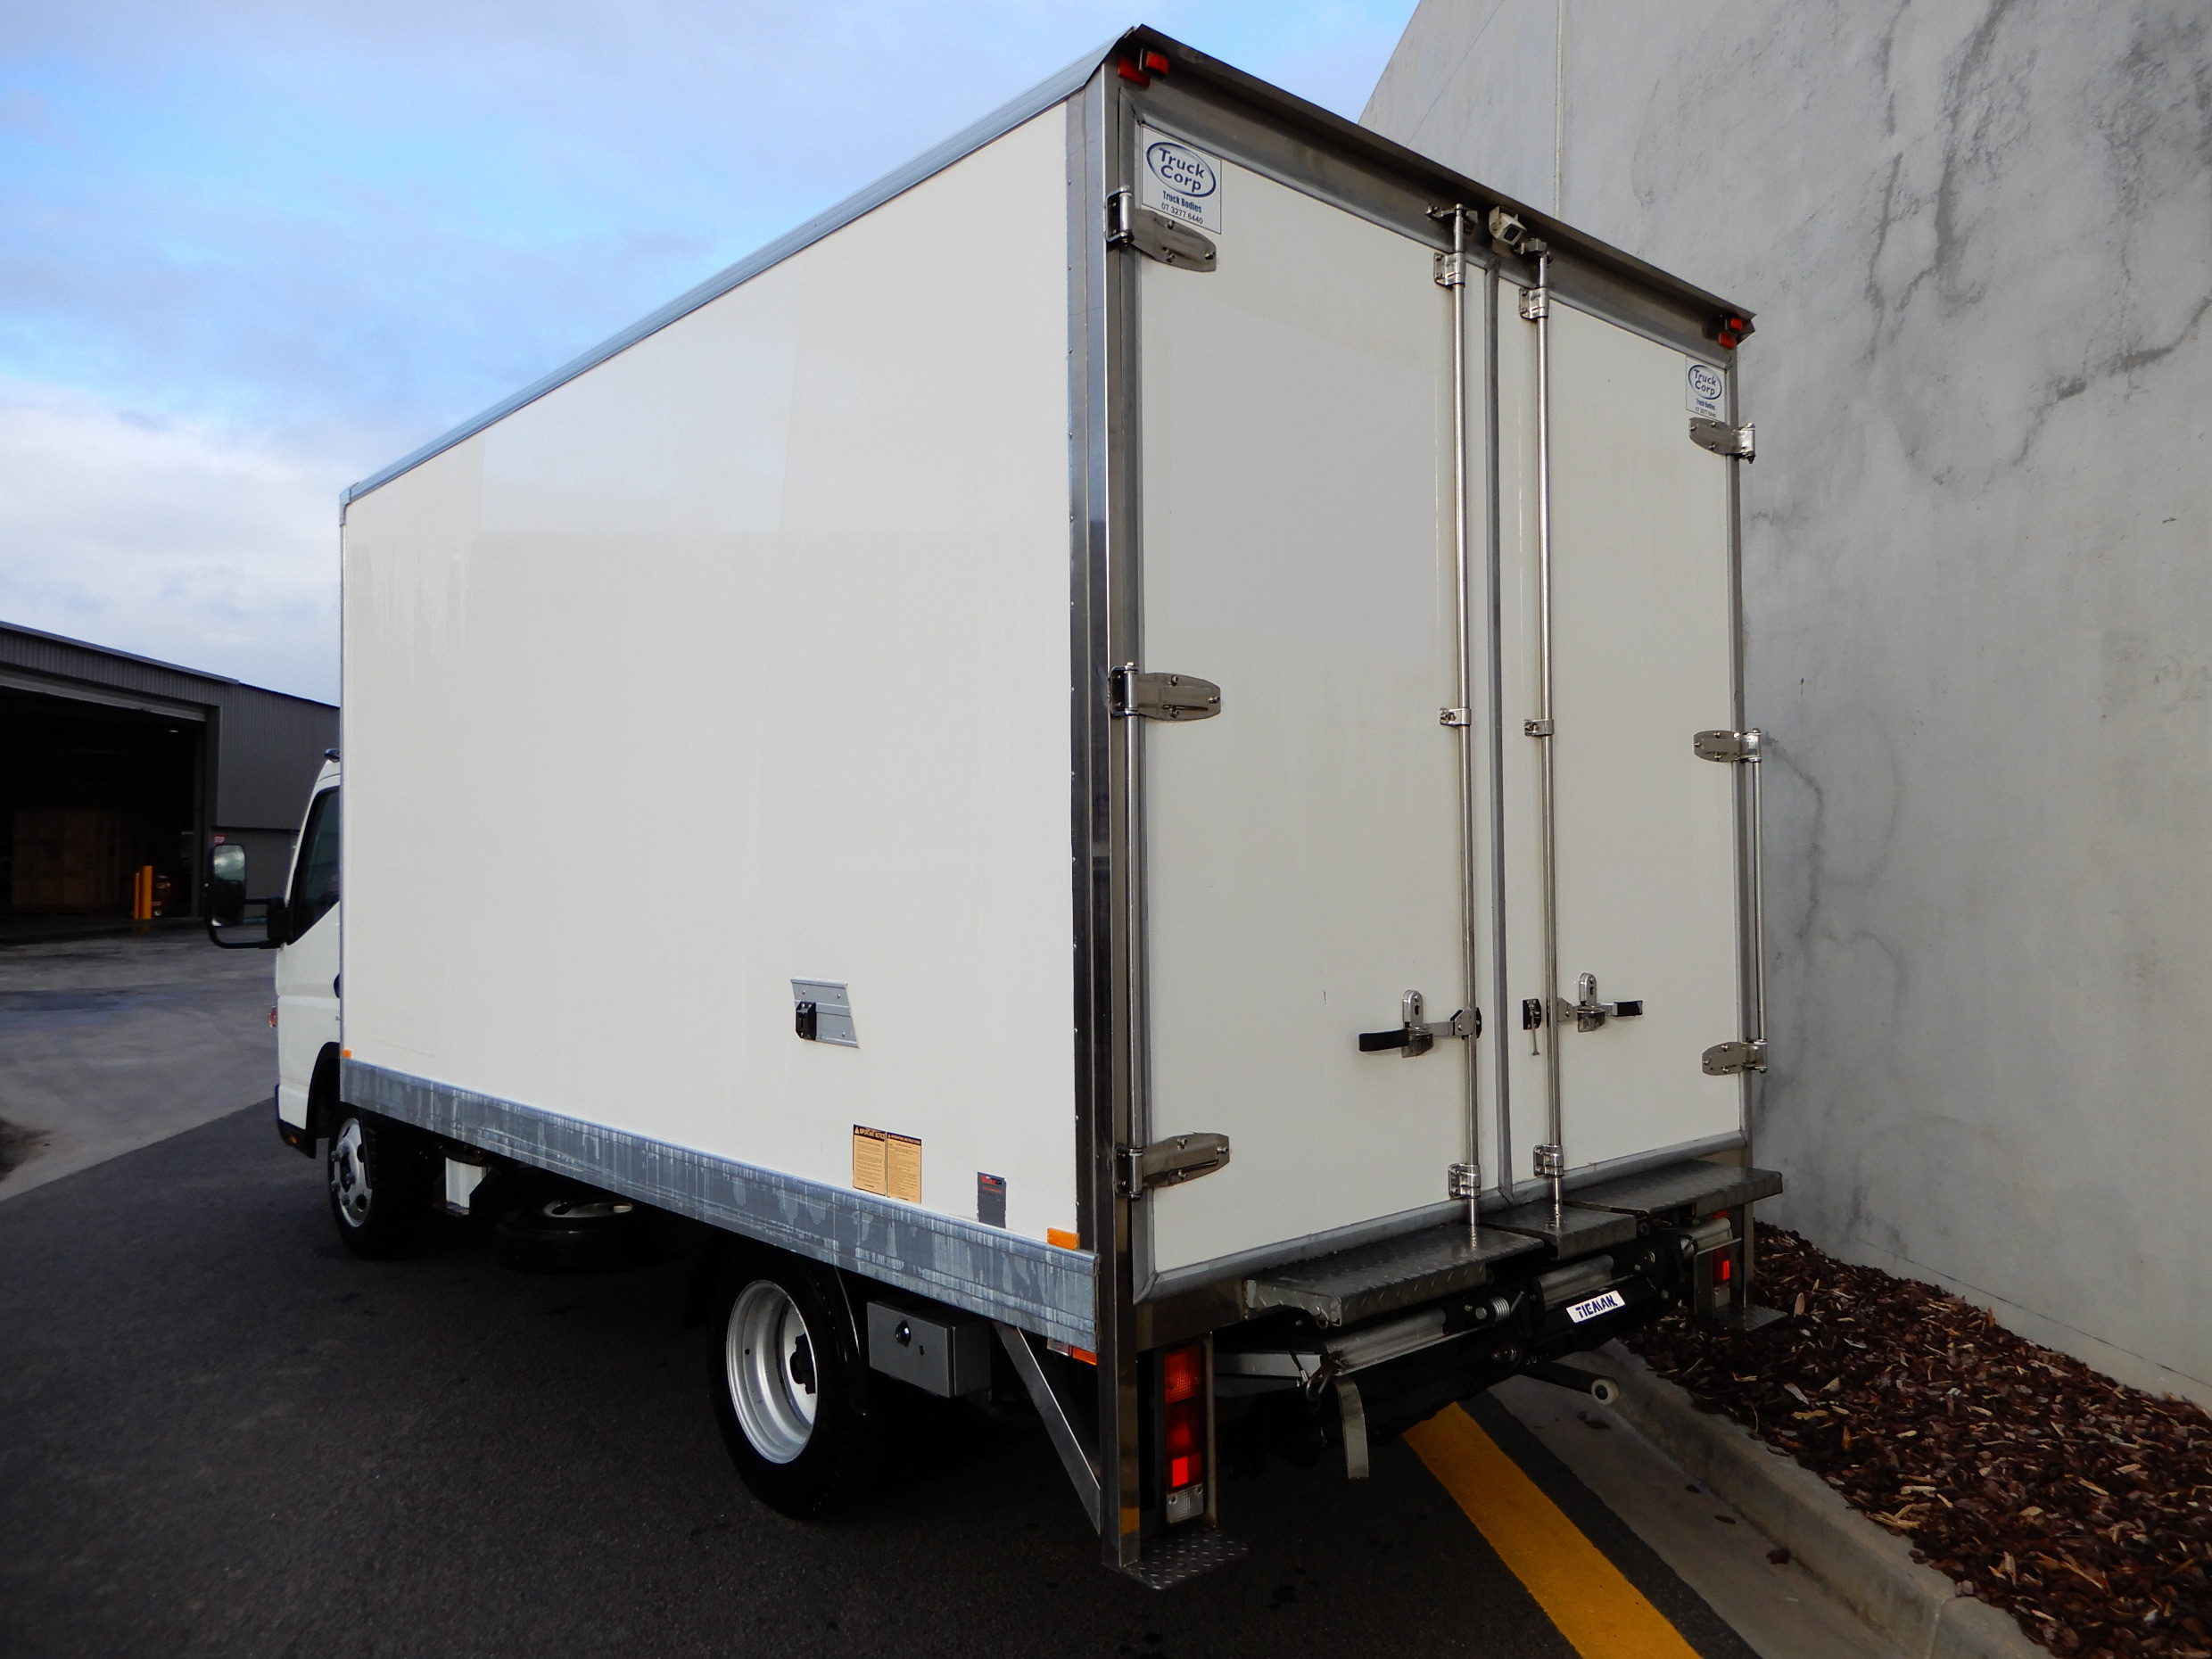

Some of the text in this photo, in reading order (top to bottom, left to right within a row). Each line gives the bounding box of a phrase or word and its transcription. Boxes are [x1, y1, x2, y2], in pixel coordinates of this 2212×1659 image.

[1159, 147, 1205, 178] Truck
[1160, 165, 1201, 193] Corp
[1162, 190, 1202, 213] Truck Bodies
[1161, 202, 1203, 225] 07 3277 6440
[1694, 369, 1717, 386] Truck
[1695, 380, 1715, 397] Corp
